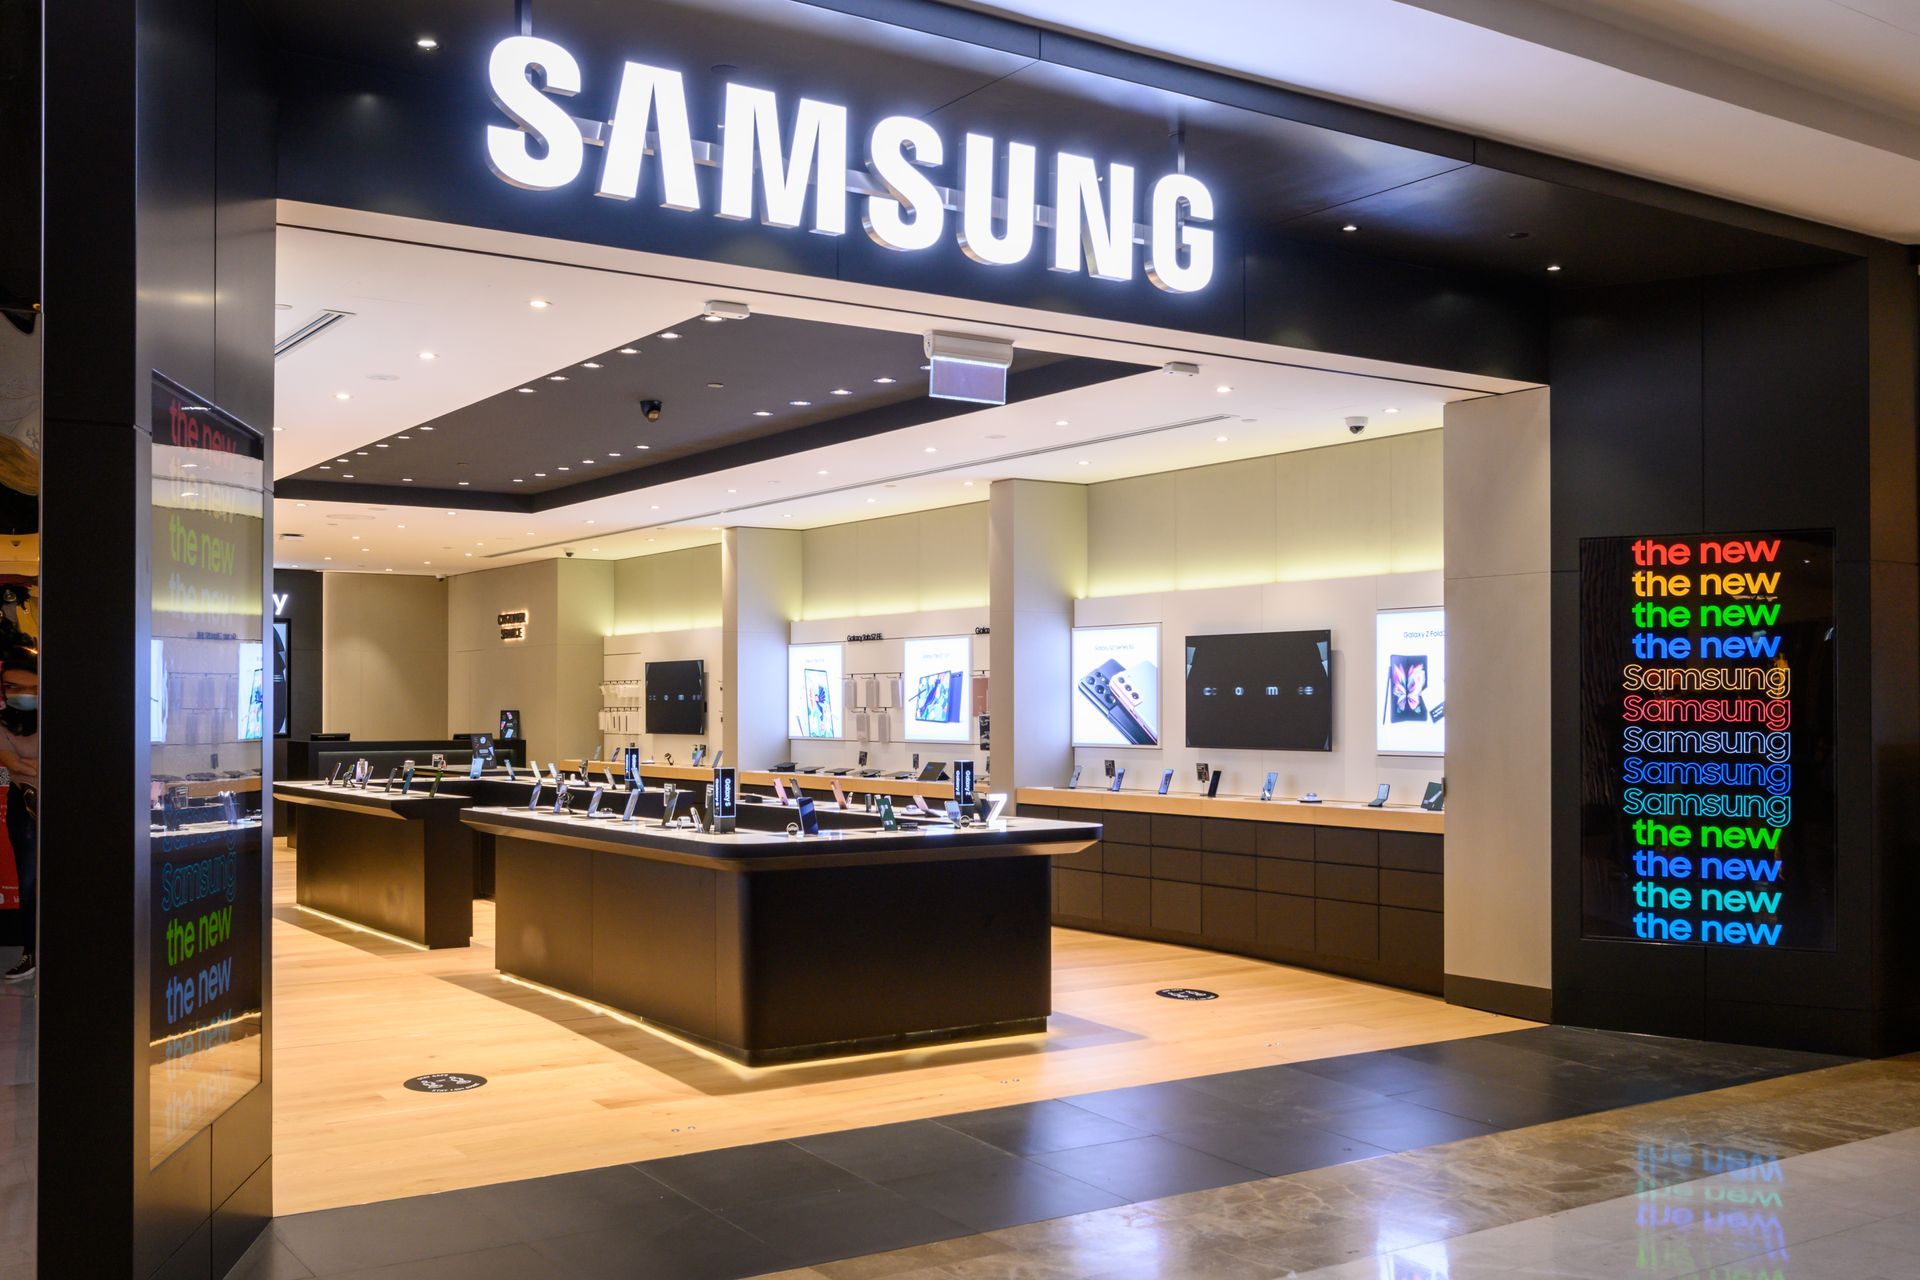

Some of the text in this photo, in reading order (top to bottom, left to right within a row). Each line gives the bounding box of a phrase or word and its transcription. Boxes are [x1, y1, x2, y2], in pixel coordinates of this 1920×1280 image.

[487, 35, 1214, 292] SAMSUNG
[169, 400, 236, 471] the new
[168, 513, 235, 576] the new
[1631, 539, 1781, 566] the new
[1631, 571, 1781, 597] the new
[1631, 602, 1781, 628] the new
[847, 634, 862, 643] Galaxy
[1403, 631, 1424, 639] Galaxy
[1425, 630, 1430, 638] Z
[1631, 633, 1781, 659] the new
[1622, 664, 1791, 699] Samsung
[1622, 695, 1791, 731] Samsung
[1622, 726, 1791, 763] Samsung
[1622, 757, 1791, 796] Samsung
[1622, 788, 1791, 828] Samsung
[1633, 818, 1782, 849] the new
[162, 851, 236, 911] Samsung
[1633, 850, 1782, 882] the new
[1633, 881, 1782, 913] the new
[166, 905, 232, 966] the new
[1633, 912, 1782, 945] the new
[166, 957, 232, 1024] the new
